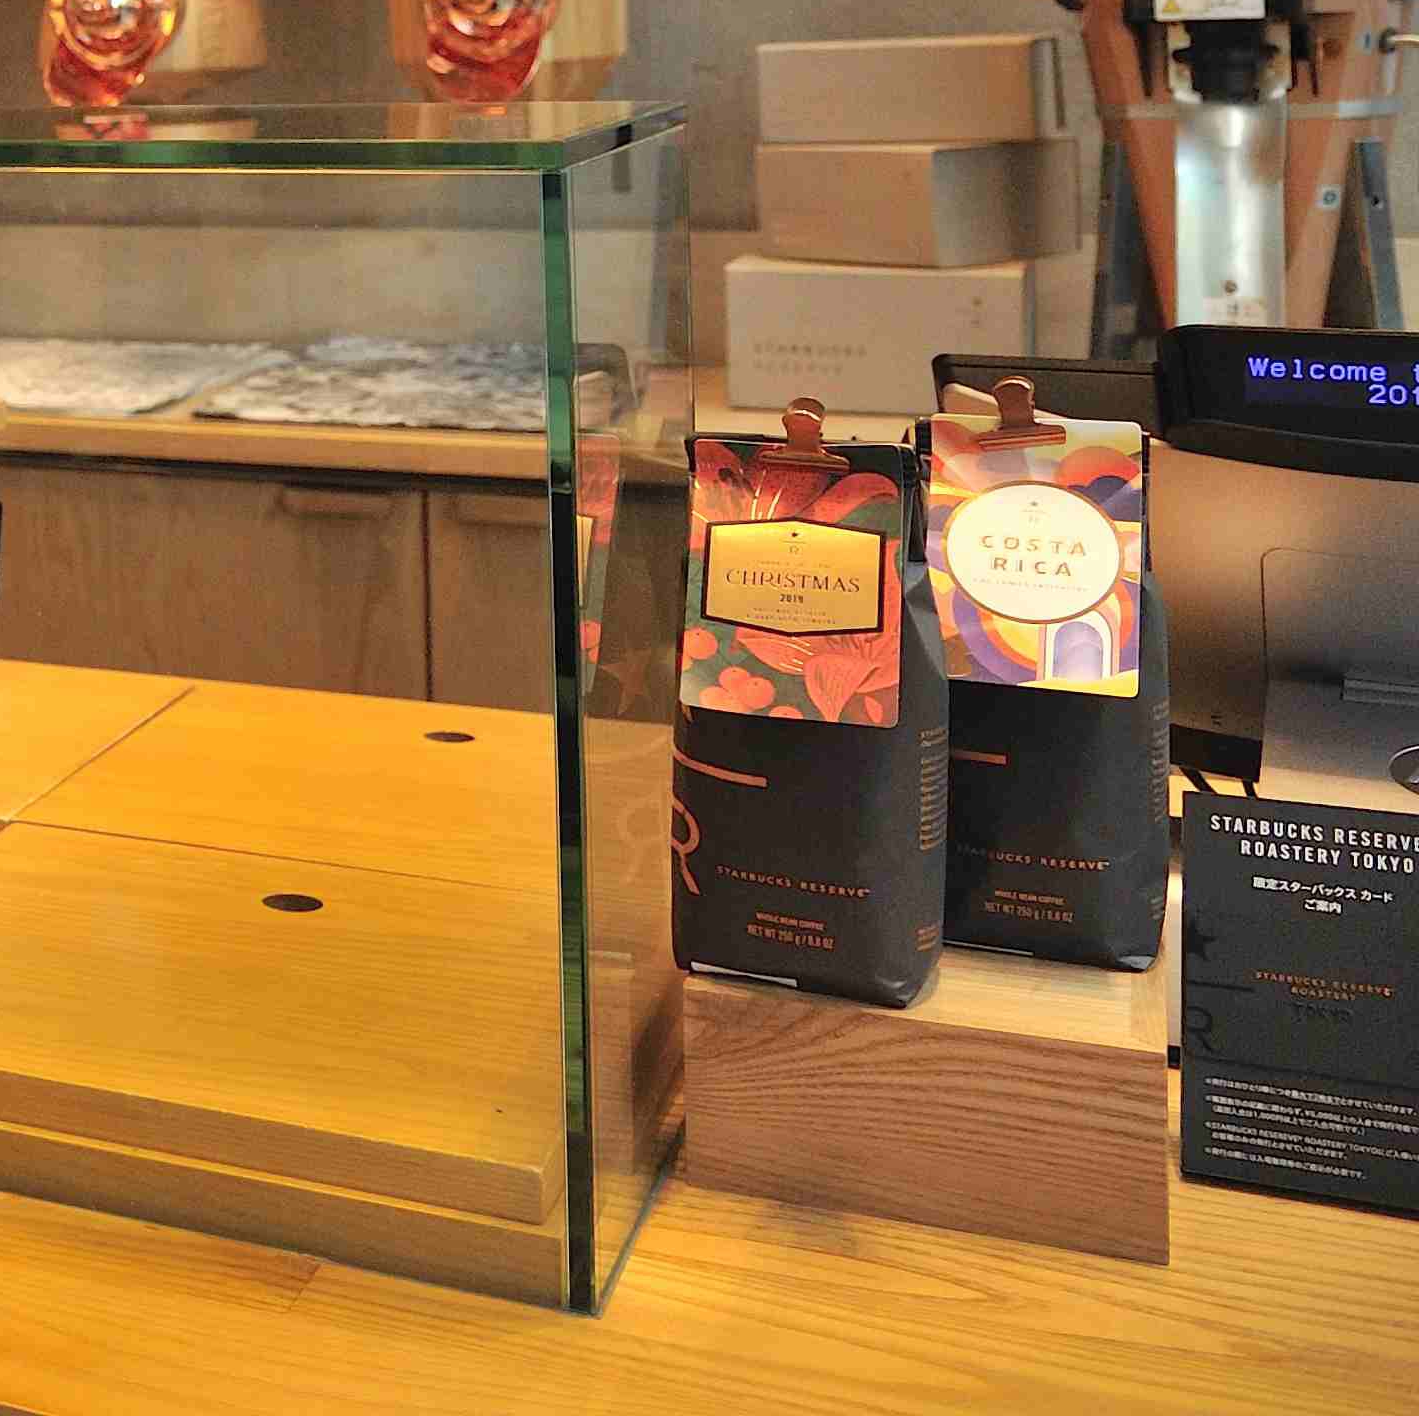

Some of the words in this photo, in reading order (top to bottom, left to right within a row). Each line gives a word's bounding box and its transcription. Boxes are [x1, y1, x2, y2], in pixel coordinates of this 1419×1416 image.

[1247, 357, 1387, 382] Welcome
[981, 535, 1087, 556] COSTA
[993, 557, 1072, 577] RICA
[726, 568, 860, 593] CHRISTMAS
[779, 593, 804, 604] 2019
[1210, 815, 1324, 842] STARBUCKS
[1240, 839, 1341, 866] ROASTERY
[1350, 851, 1414, 874] TOKYO
[716, 865, 791, 888] STARBUCKS
[1304, 898, 1342, 915] ご案内
[1255, 971, 1326, 987] STARBUCKS
